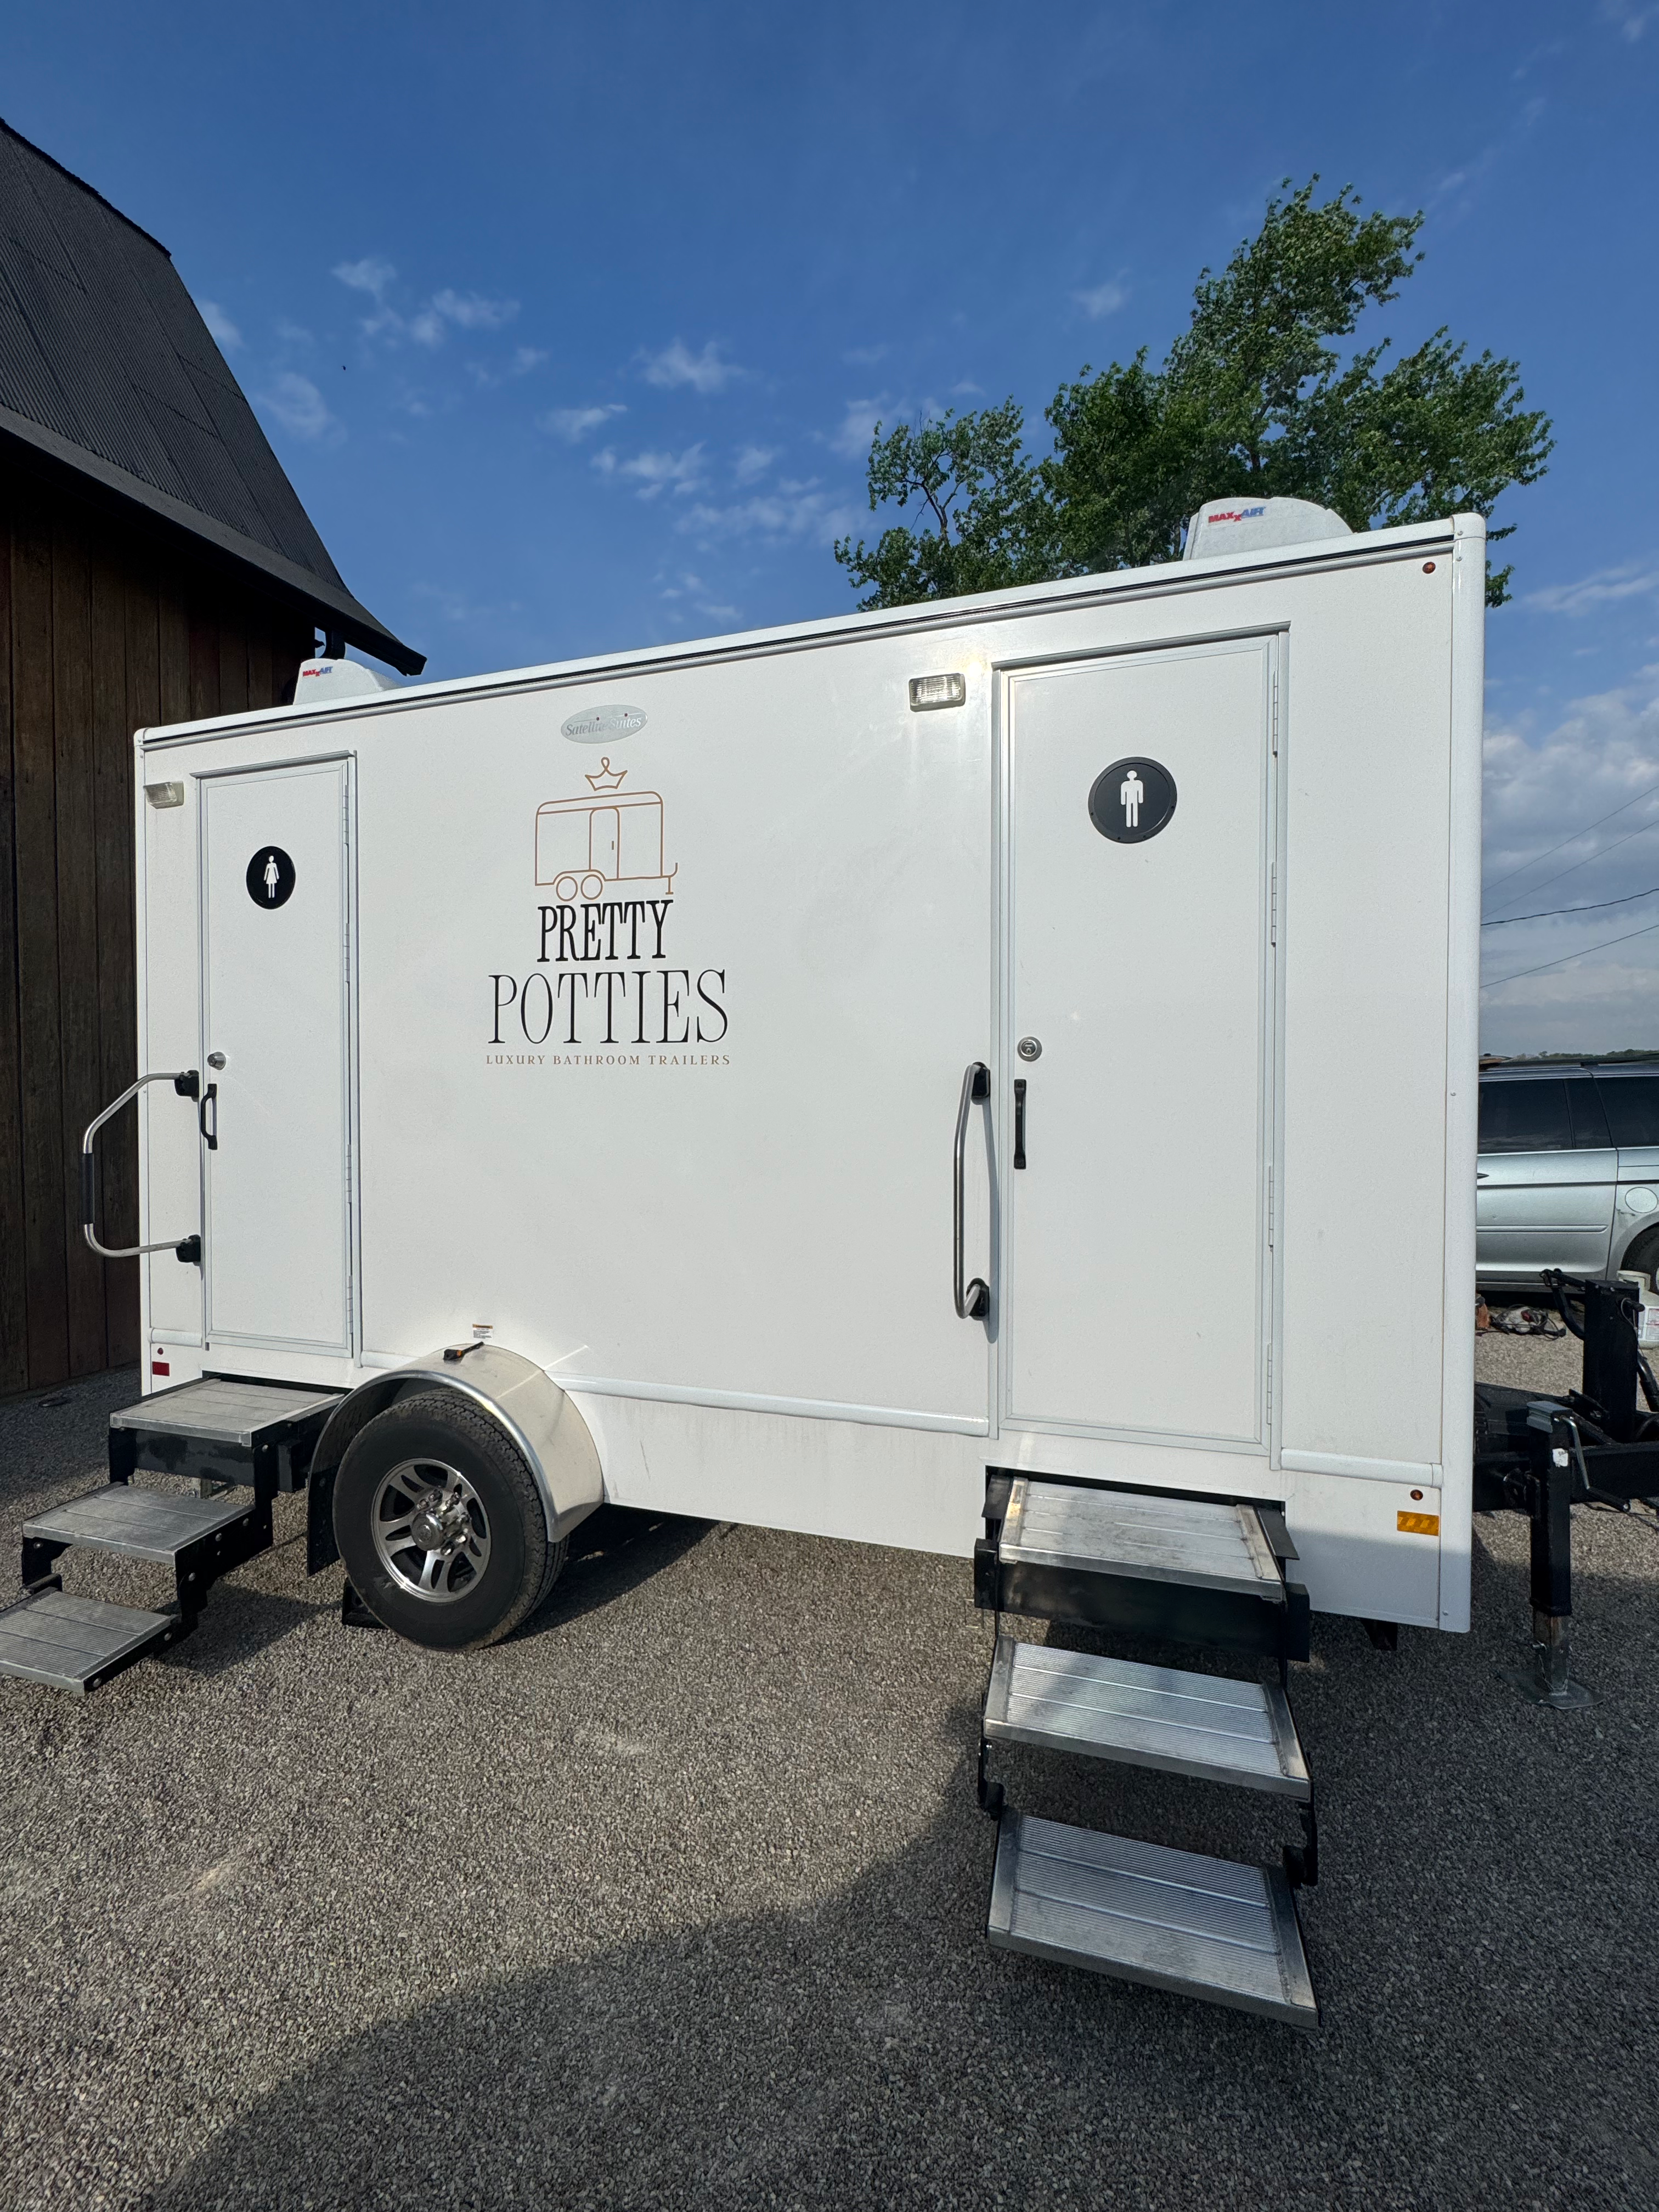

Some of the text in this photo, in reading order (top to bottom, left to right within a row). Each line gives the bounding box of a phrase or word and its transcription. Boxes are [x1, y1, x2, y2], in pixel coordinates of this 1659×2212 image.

[610, 717, 641, 729] Suites
[537, 899, 674, 962] PRETTY
[488, 969, 728, 1044] POTTIES
[486, 1054, 731, 1065] LUXURY BATHROOM TRAILERS
